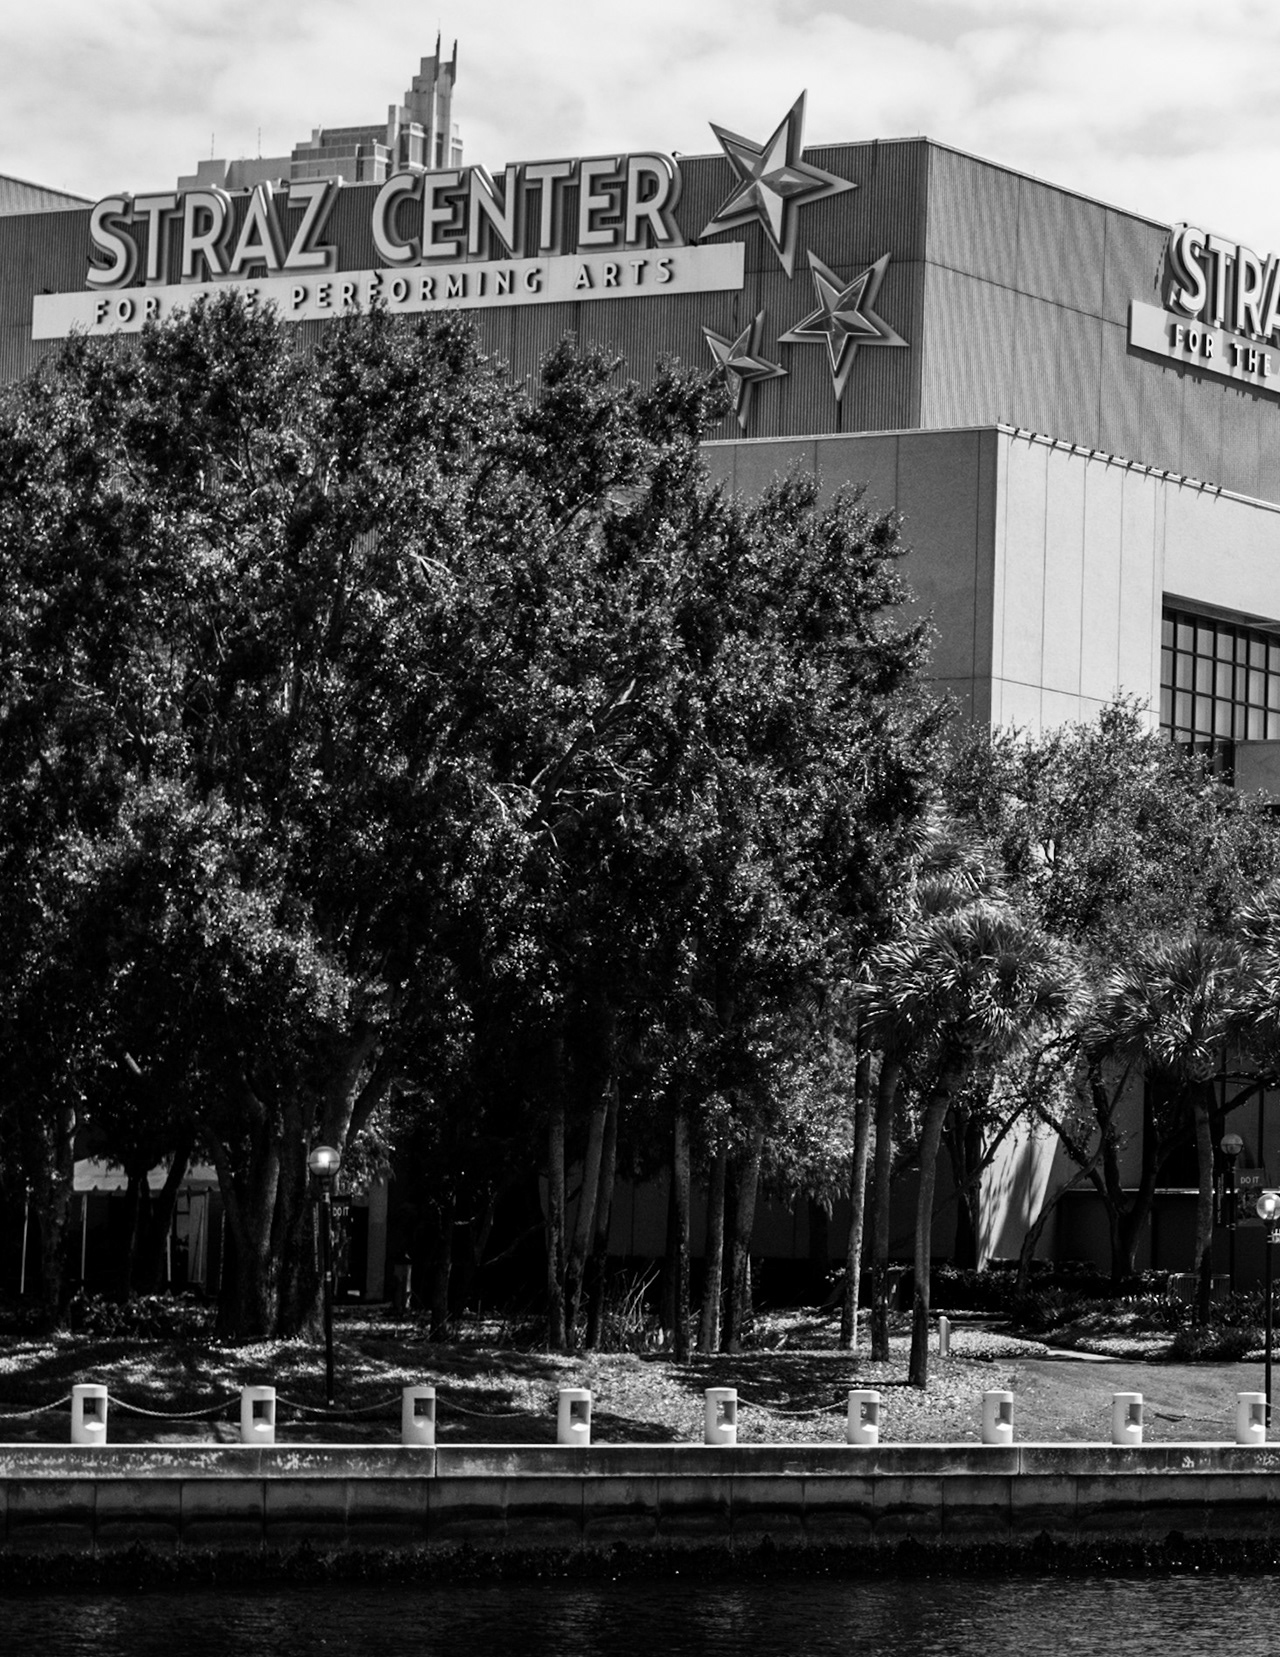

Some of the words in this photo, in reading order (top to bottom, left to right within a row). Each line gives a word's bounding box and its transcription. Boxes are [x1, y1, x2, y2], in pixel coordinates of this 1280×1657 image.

[86, 178, 332, 286] STRAZ
[371, 153, 679, 262] CENTER
[95, 297, 161, 324] FOR
[291, 267, 543, 310] PERFORMING
[574, 257, 674, 290] ARTS
[1174, 323, 1214, 358] FOR
[1231, 342, 1272, 377] THE
[1240, 1176, 1251, 1185] DO
[1252, 1176, 1259, 1184] IT
[332, 1206, 342, 1217] DO
